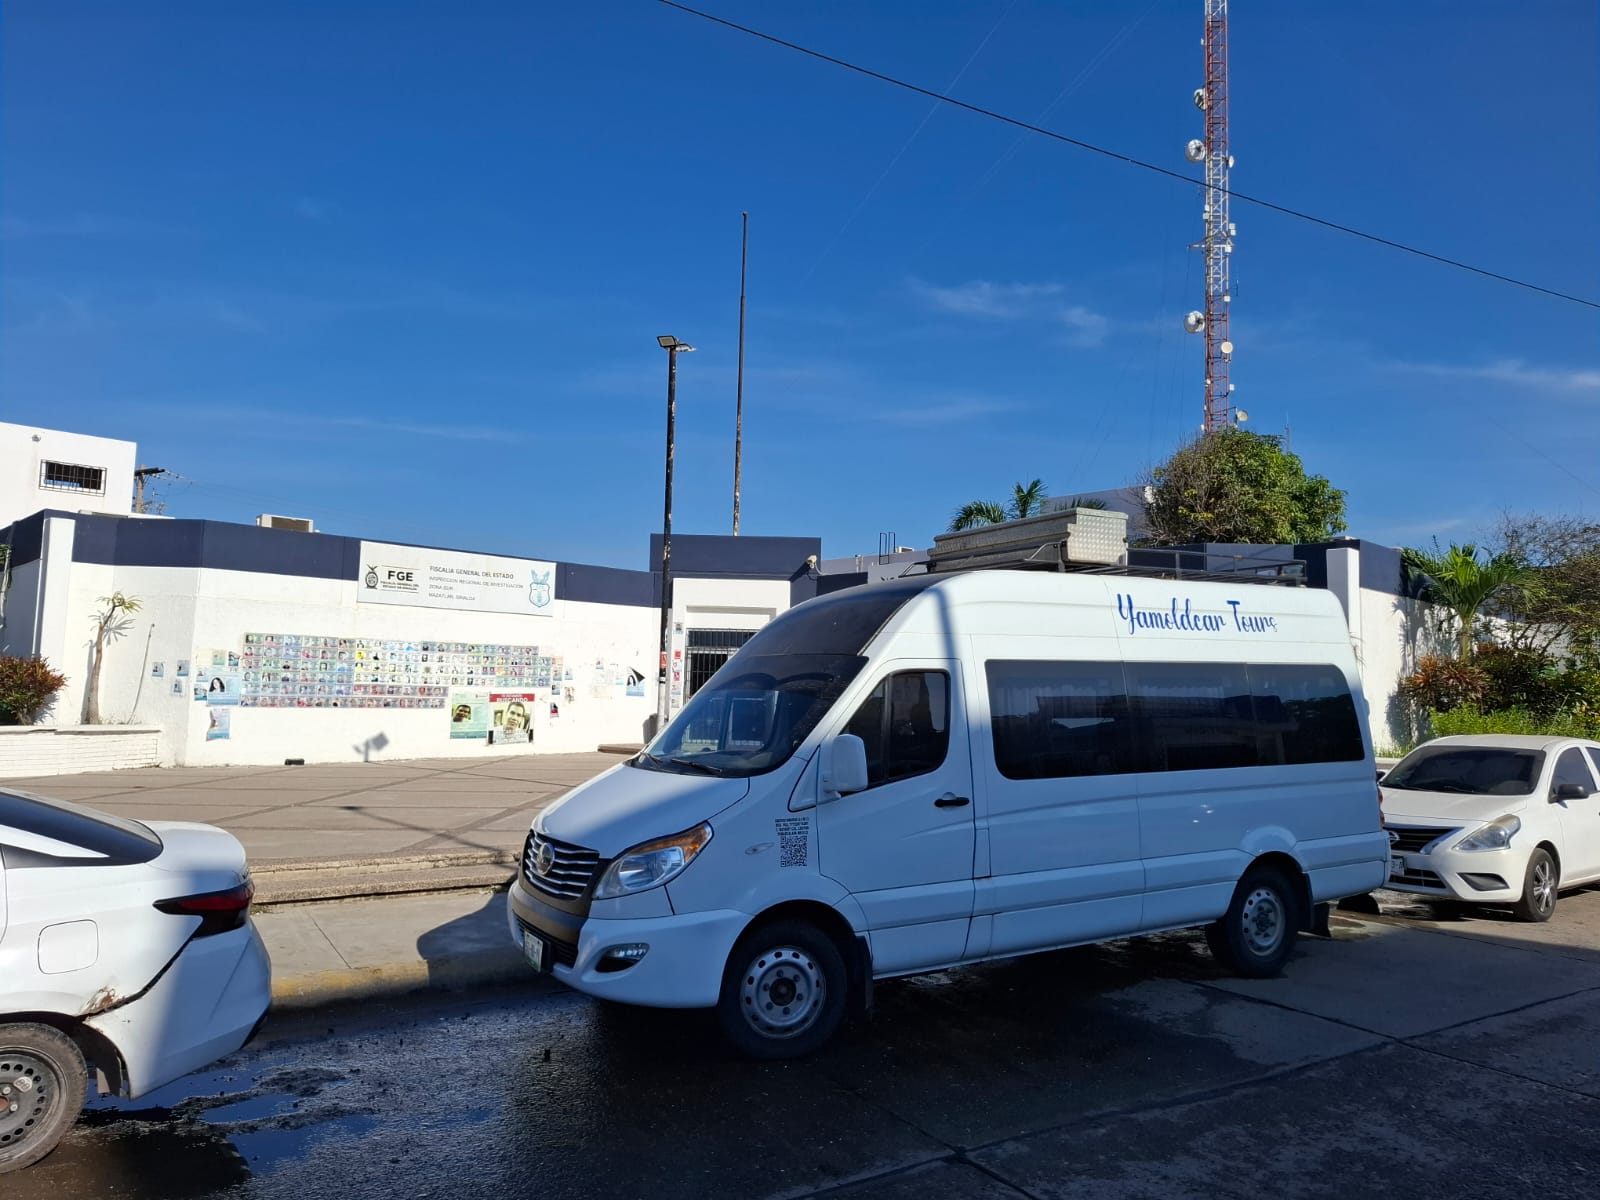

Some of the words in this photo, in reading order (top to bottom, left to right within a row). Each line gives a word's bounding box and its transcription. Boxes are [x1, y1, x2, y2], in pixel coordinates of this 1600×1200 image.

[387, 570, 414, 582] FGE
[455, 568, 480, 577] GENERAL
[493, 572, 514, 580] ESTADO
[1226, 600, 1278, 633] Tours
